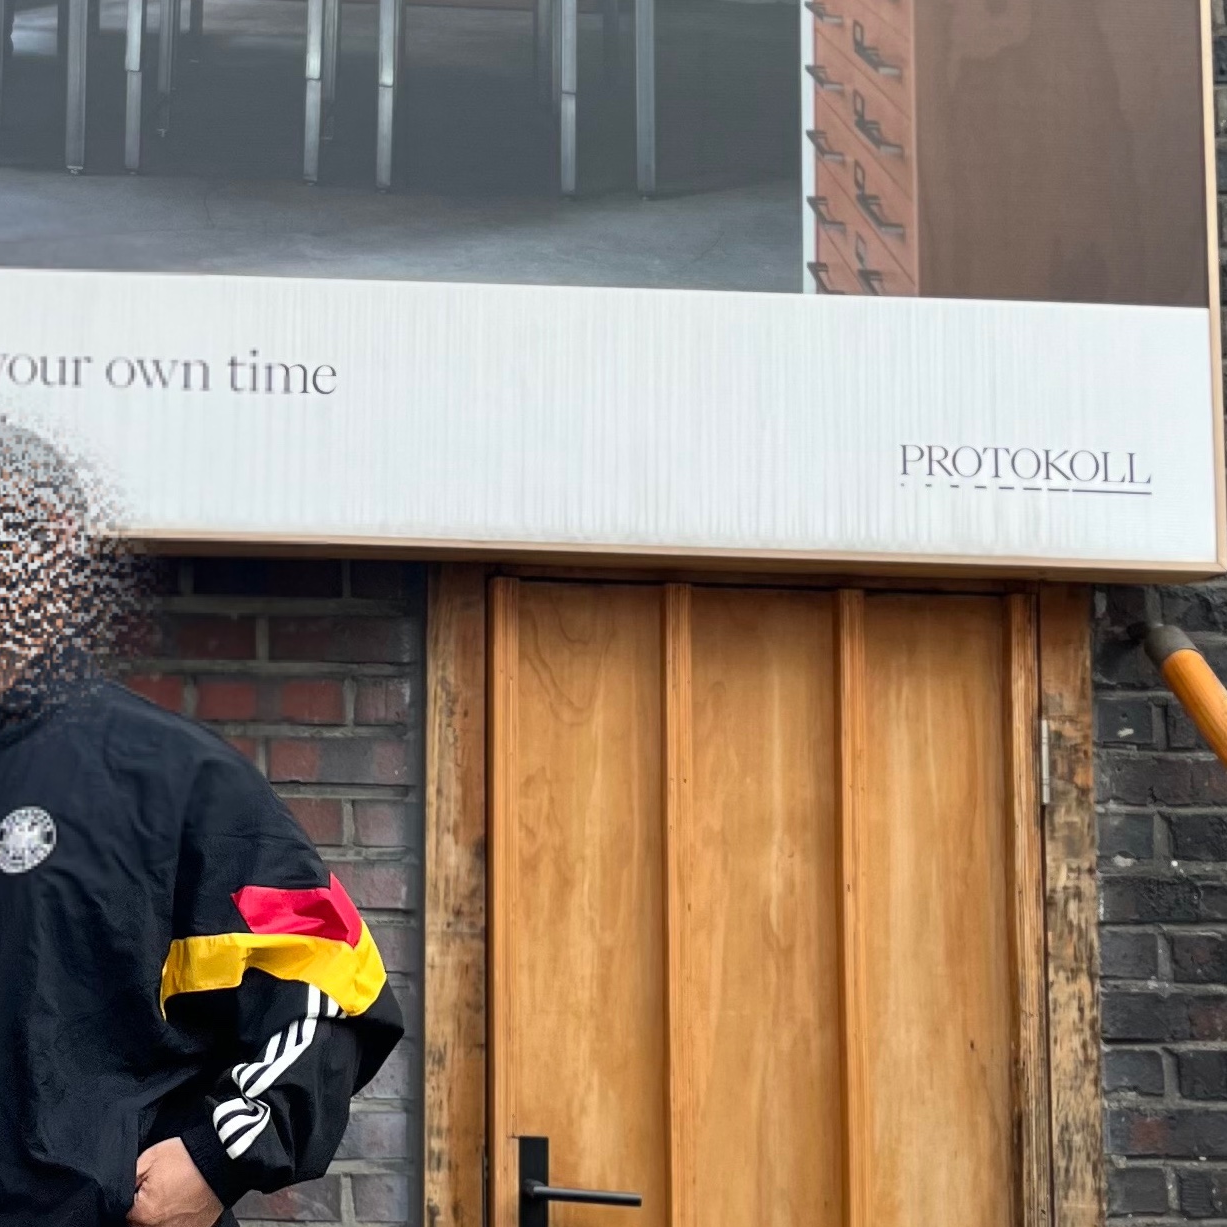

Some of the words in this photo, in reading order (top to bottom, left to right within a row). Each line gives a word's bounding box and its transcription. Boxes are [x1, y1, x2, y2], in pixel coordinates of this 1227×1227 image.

[105, 355, 211, 391] own
[227, 348, 337, 396] time
[899, 443, 1152, 485] PROTOKOLL
